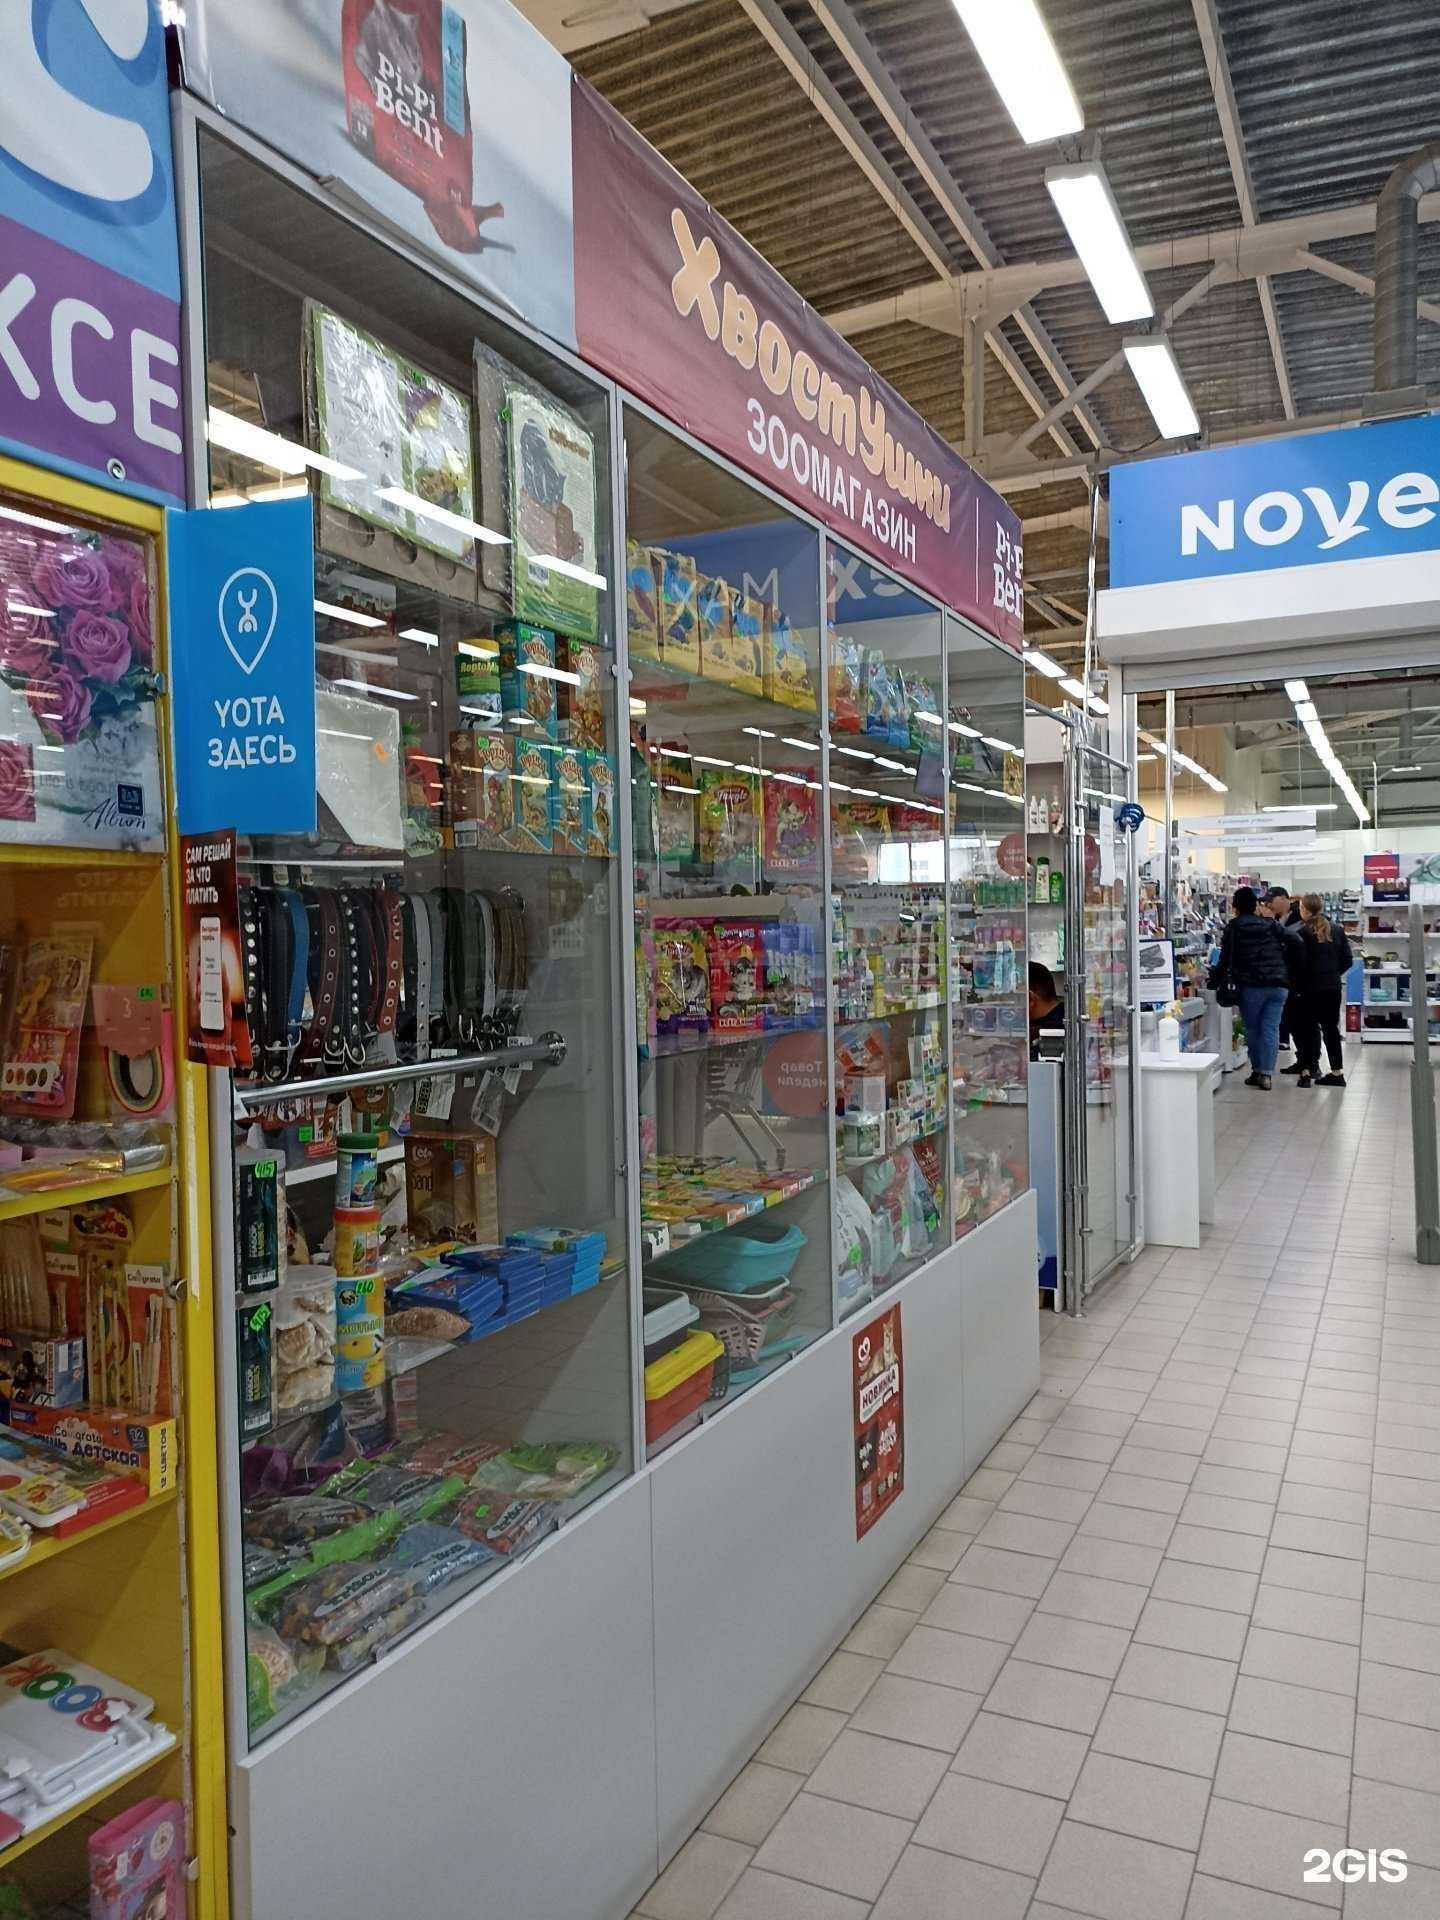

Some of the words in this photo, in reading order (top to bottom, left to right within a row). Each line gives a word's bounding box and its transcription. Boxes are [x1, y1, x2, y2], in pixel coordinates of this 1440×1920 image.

[374, 75, 444, 159] Bent
[746, 398, 917, 564] ЗООМАГАЗИН
[214, 695, 285, 729] YOTA
[207, 734, 297, 771] ЗДЕСЬ
[82, 798, 146, 831] Album
[186, 846, 203, 864] САМ
[203, 837, 232, 863] РЕШАЙ
[186, 867, 195, 884] ЗА
[196, 865, 212, 884] ЧТО
[186, 886, 219, 905] ПЛАТИТЬ
